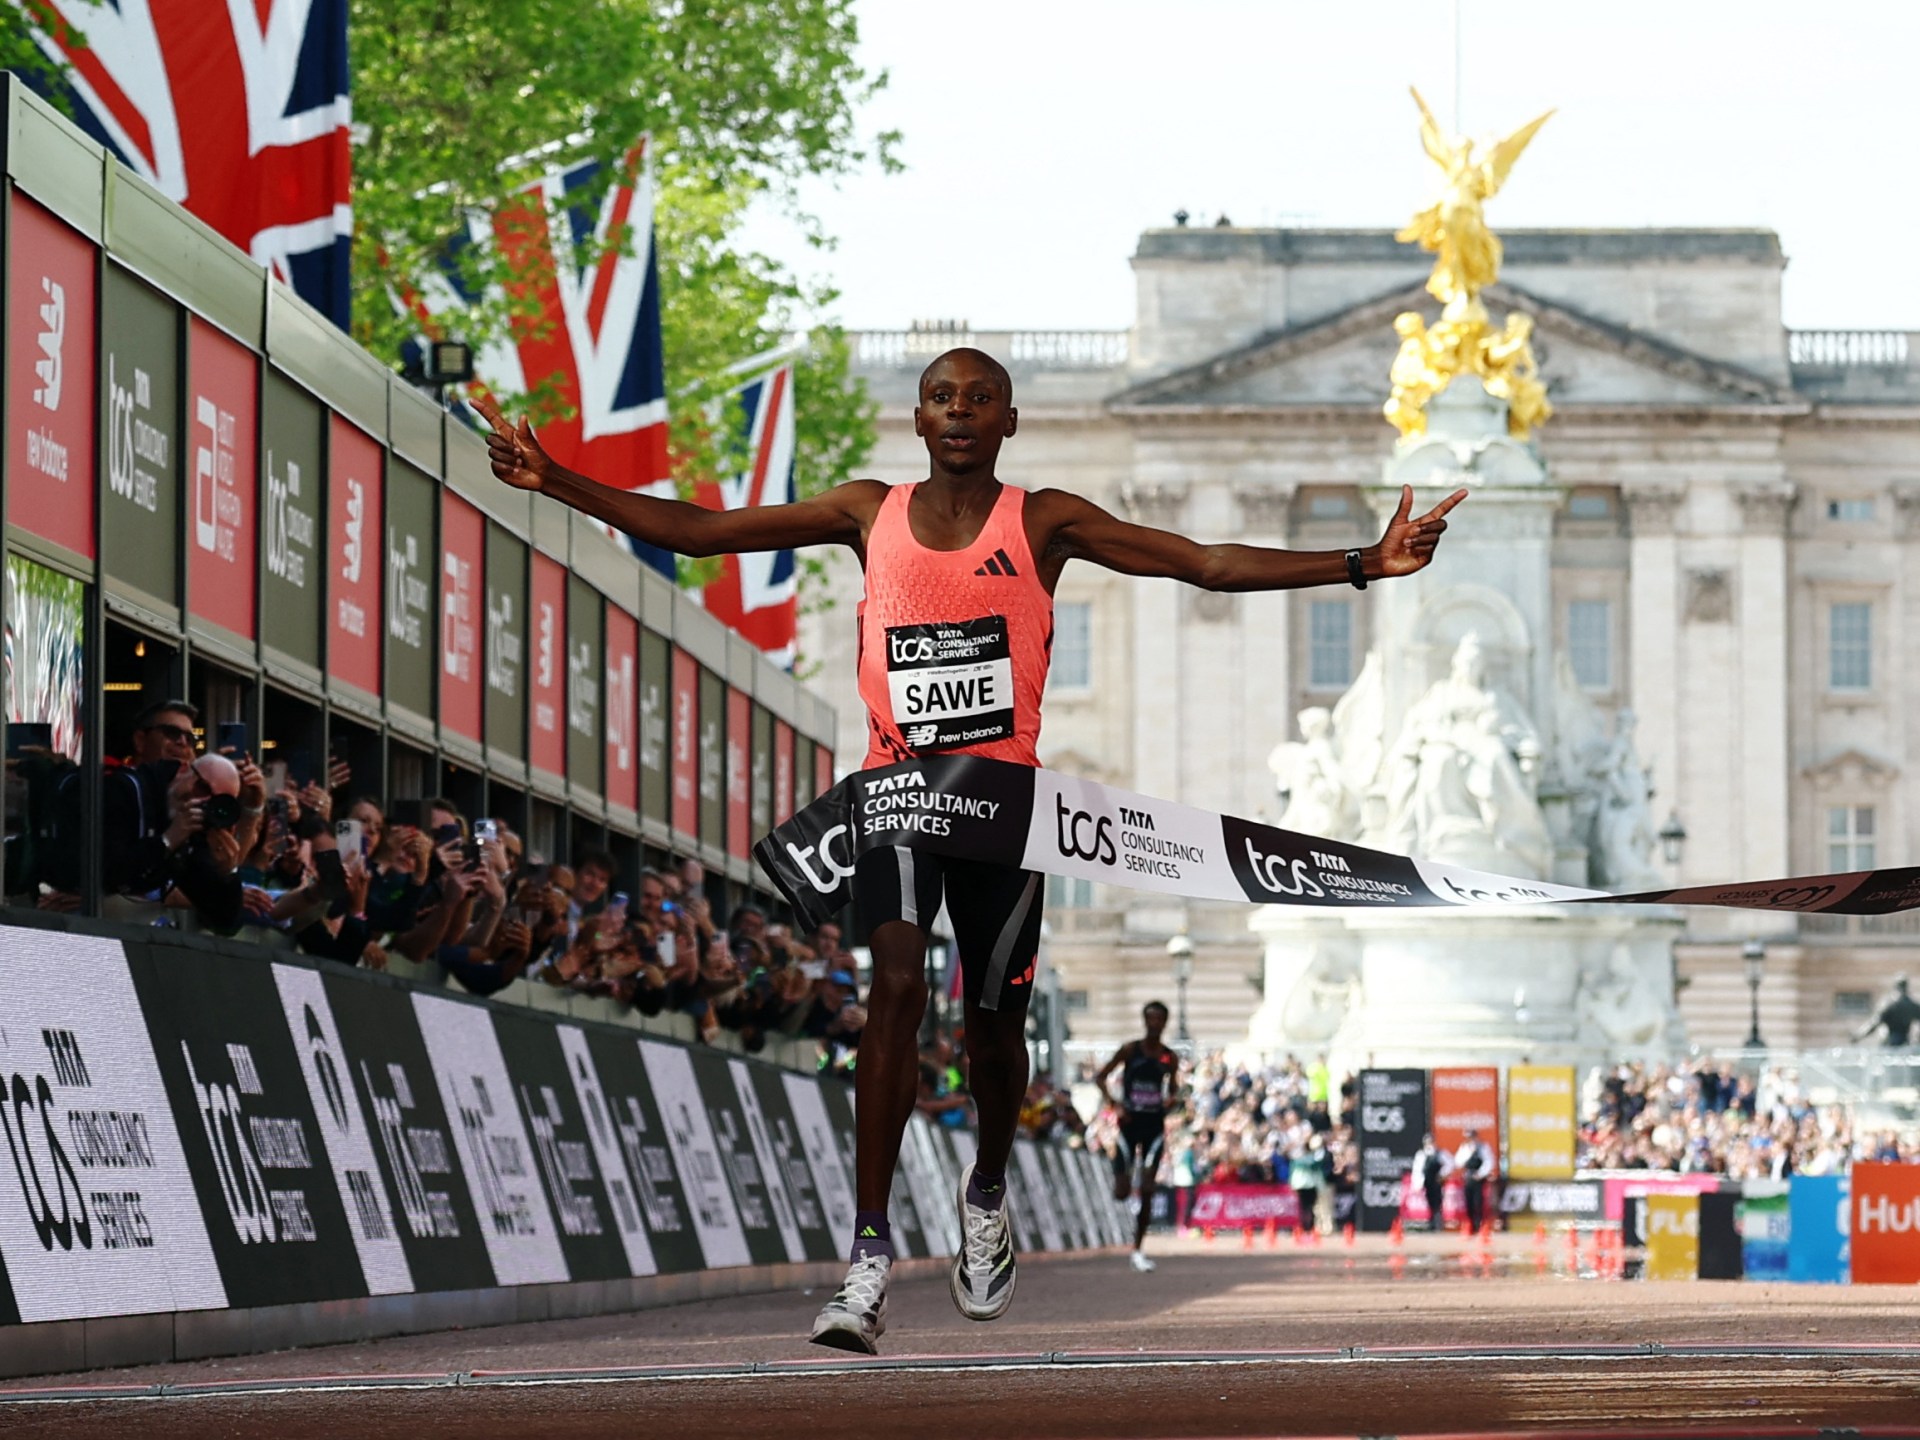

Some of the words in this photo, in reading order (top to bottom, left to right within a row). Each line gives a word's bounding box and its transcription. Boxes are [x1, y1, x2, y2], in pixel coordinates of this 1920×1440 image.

[109, 352, 134, 499] tcs
[891, 634, 934, 663] tcs
[936, 630, 964, 639] TATA
[937, 634, 999, 649] CONSULTANCY
[938, 647, 980, 659] SERVICES
[906, 676, 995, 715] SAWE
[939, 733, 960, 743] new
[963, 726, 1002, 740] balance
[864, 770, 927, 796] TATA
[863, 791, 1000, 820] CONSULTANCY
[1119, 807, 1155, 831] TATA
[863, 813, 952, 837] SERVICES
[1056, 791, 1117, 866] tcs
[785, 823, 857, 894] tc
[1121, 830, 1205, 864] CONSULTANCY
[1309, 850, 1351, 873] TATA
[1124, 853, 1181, 879] SERVICES
[1245, 837, 1325, 898] tcs
[1318, 872, 1413, 896] CONSULTANCY
[41, 1027, 92, 1088] TATA
[1362, 1105, 1406, 1133] tcs
[68, 1110, 156, 1168] CONSULTANCY
[181, 1039, 277, 1245] tcs
[91, 1191, 153, 1250] SERVICES
